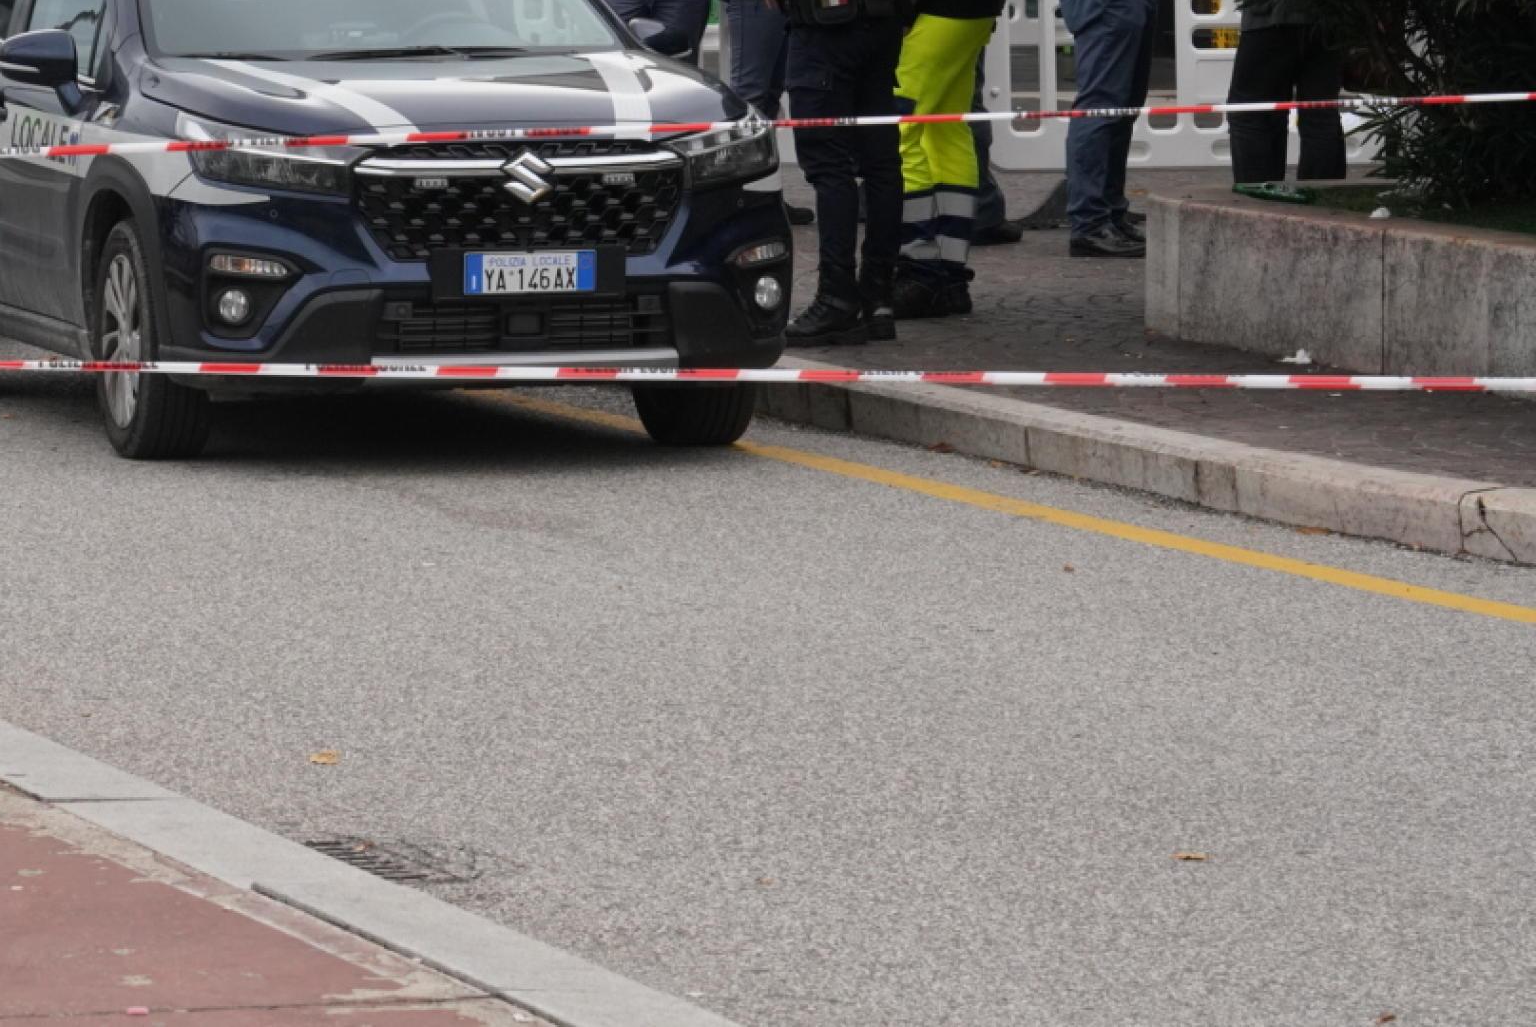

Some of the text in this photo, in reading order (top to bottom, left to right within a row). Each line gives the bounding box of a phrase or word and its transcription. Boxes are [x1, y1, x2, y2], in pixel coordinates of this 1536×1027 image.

[11, 112, 71, 164] LOCALE
[488, 255, 572, 267] POLIZIA LOCALE
